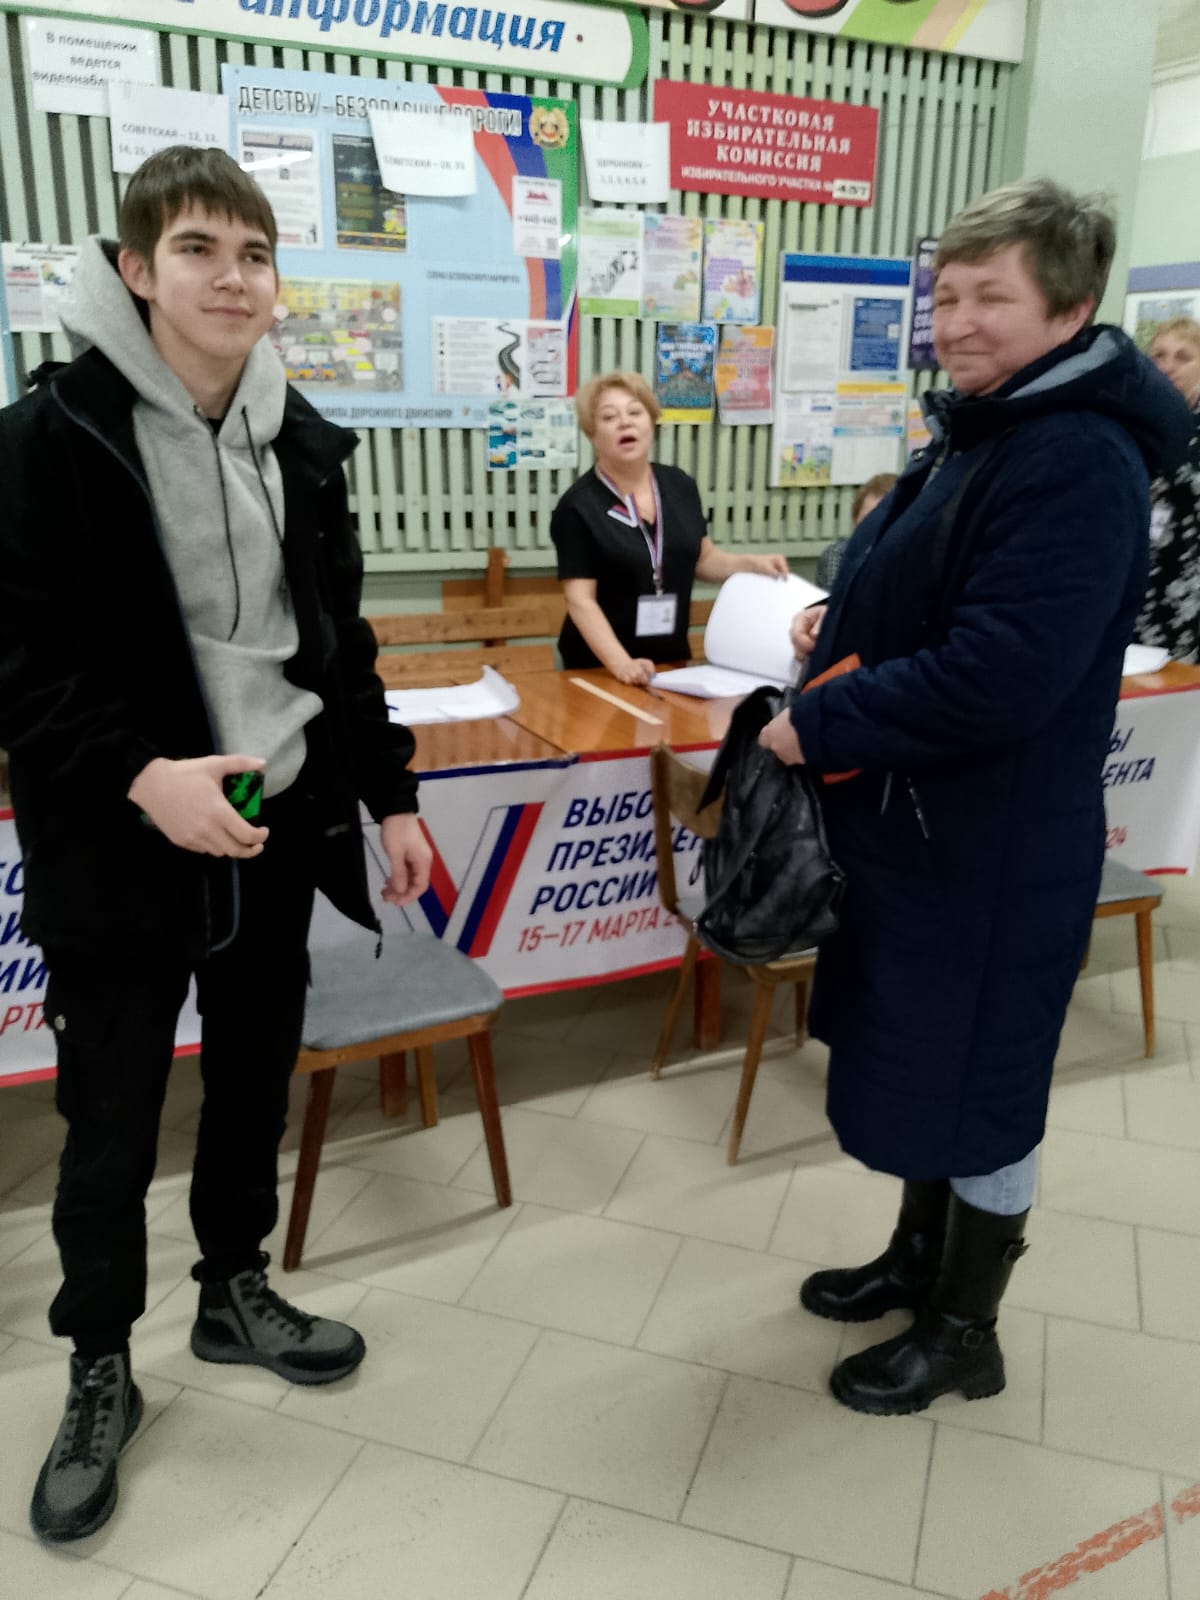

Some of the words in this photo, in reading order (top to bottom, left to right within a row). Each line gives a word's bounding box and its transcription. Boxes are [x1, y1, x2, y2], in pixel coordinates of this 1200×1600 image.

[46, 31, 55, 44] В
[58, 35, 137, 52] помещении
[70, 56, 121, 69] ведется
[239, 86, 318, 113] ДЕТСТВУ
[707, 99, 835, 132] УЧАСТКОВАЯ
[121, 123, 178, 138] СОВЕТСКАЯ
[686, 119, 852, 155] ИЗБИРАТЕЛЬНАЯ
[716, 144, 822, 172] КОМИССИЯ
[681, 165, 777, 187] ИЗБИРАТЕЛЬНОГО
[529, 869, 658, 915] РОССИИ
[586, 906, 660, 944] МАРТА
